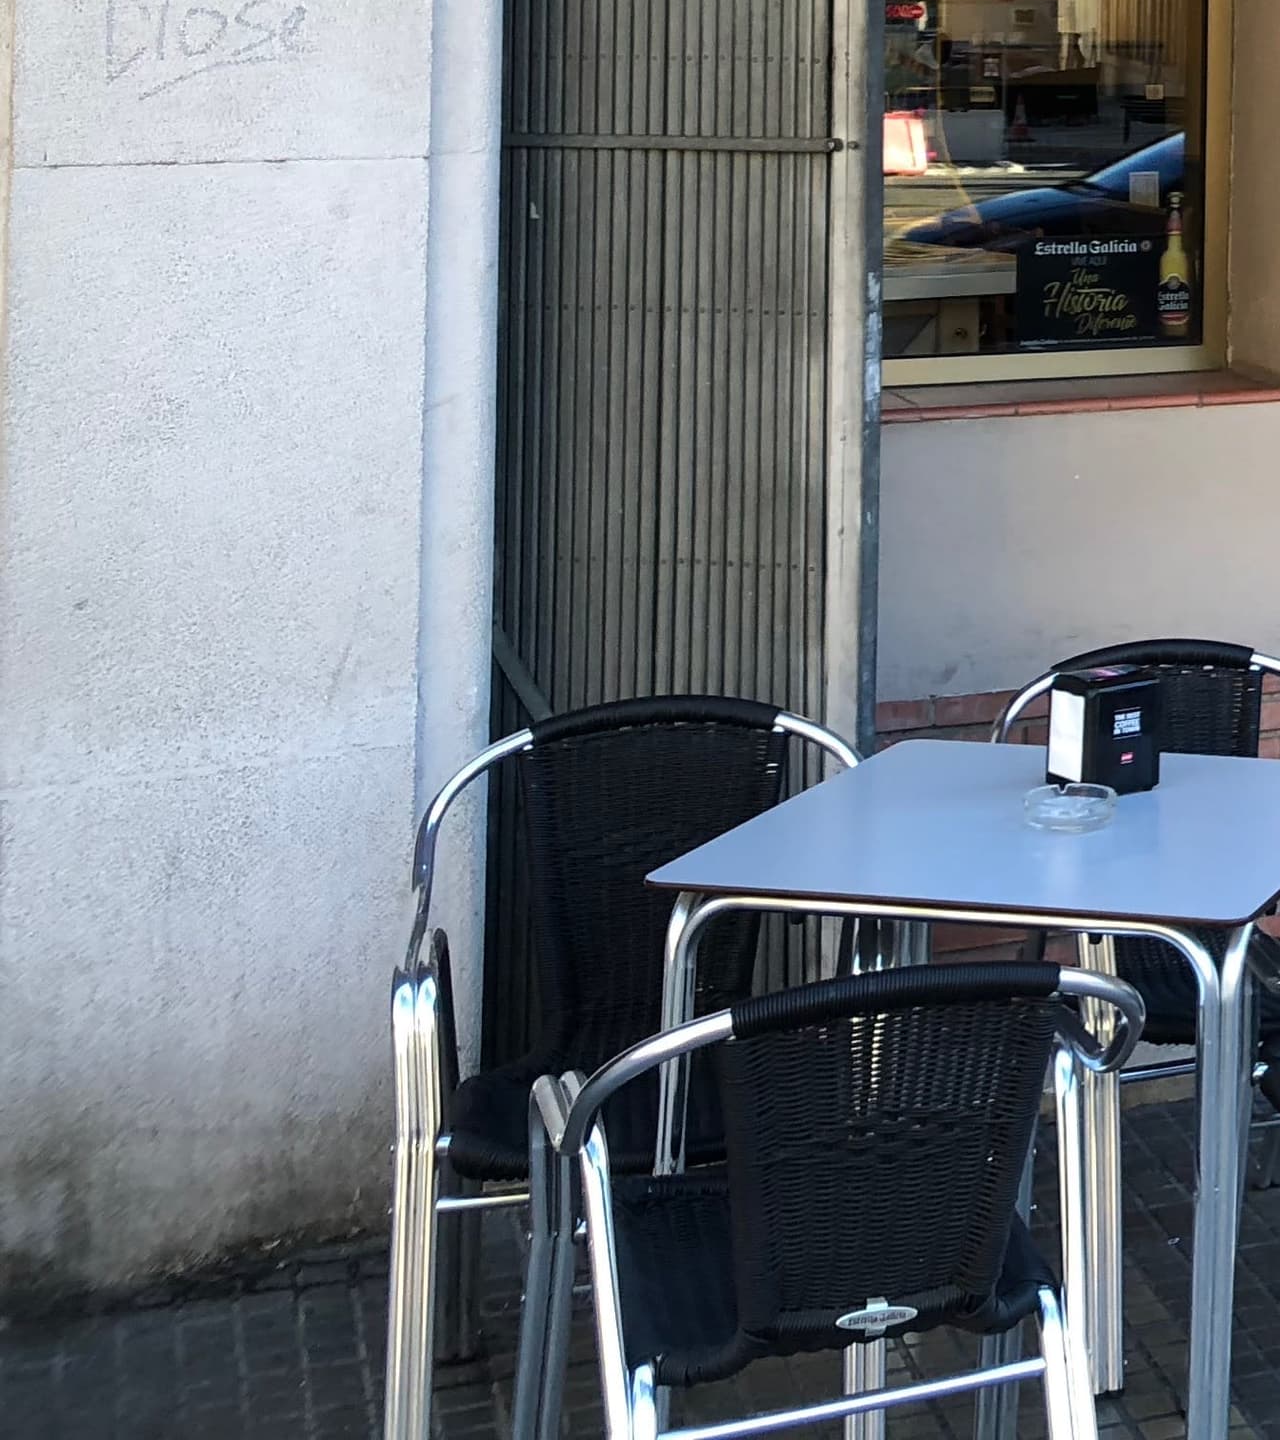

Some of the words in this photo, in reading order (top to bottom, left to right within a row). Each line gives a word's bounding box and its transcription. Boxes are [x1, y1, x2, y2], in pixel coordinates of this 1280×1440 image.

[1034, 241, 1087, 255] Estrella
[1089, 240, 1137, 254] Galicia
[1043, 281, 1128, 318] Historia
